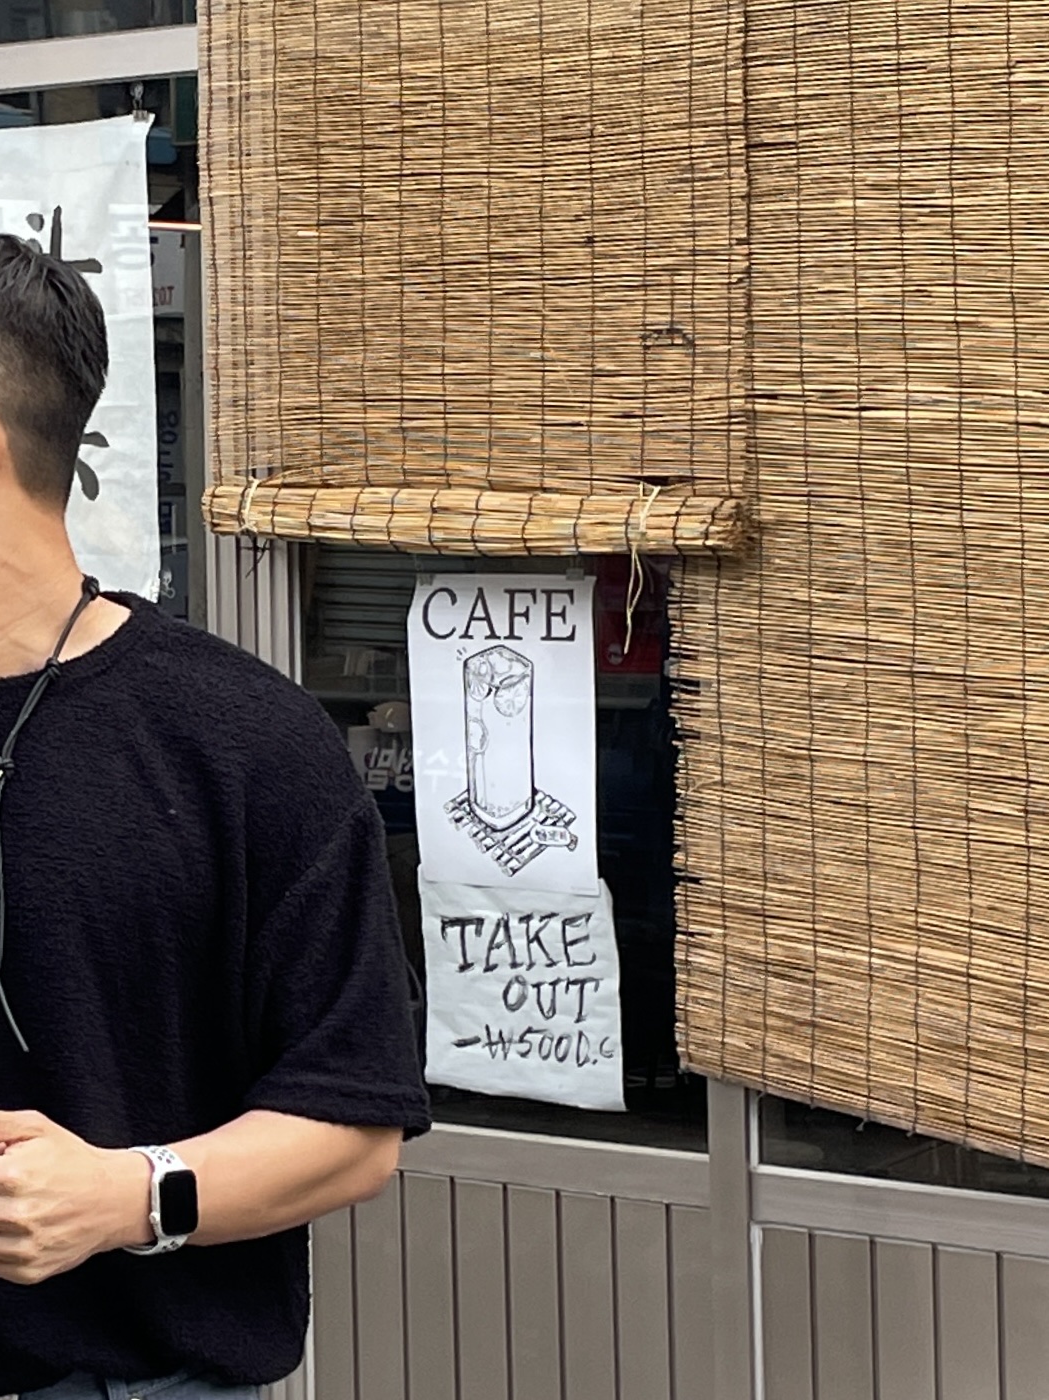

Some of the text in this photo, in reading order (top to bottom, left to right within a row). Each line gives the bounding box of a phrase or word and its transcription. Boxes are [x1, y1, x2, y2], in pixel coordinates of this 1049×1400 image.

[422, 587, 577, 642] CAFE
[440, 912, 597, 974] TAKE
[502, 974, 603, 1023] OUT
